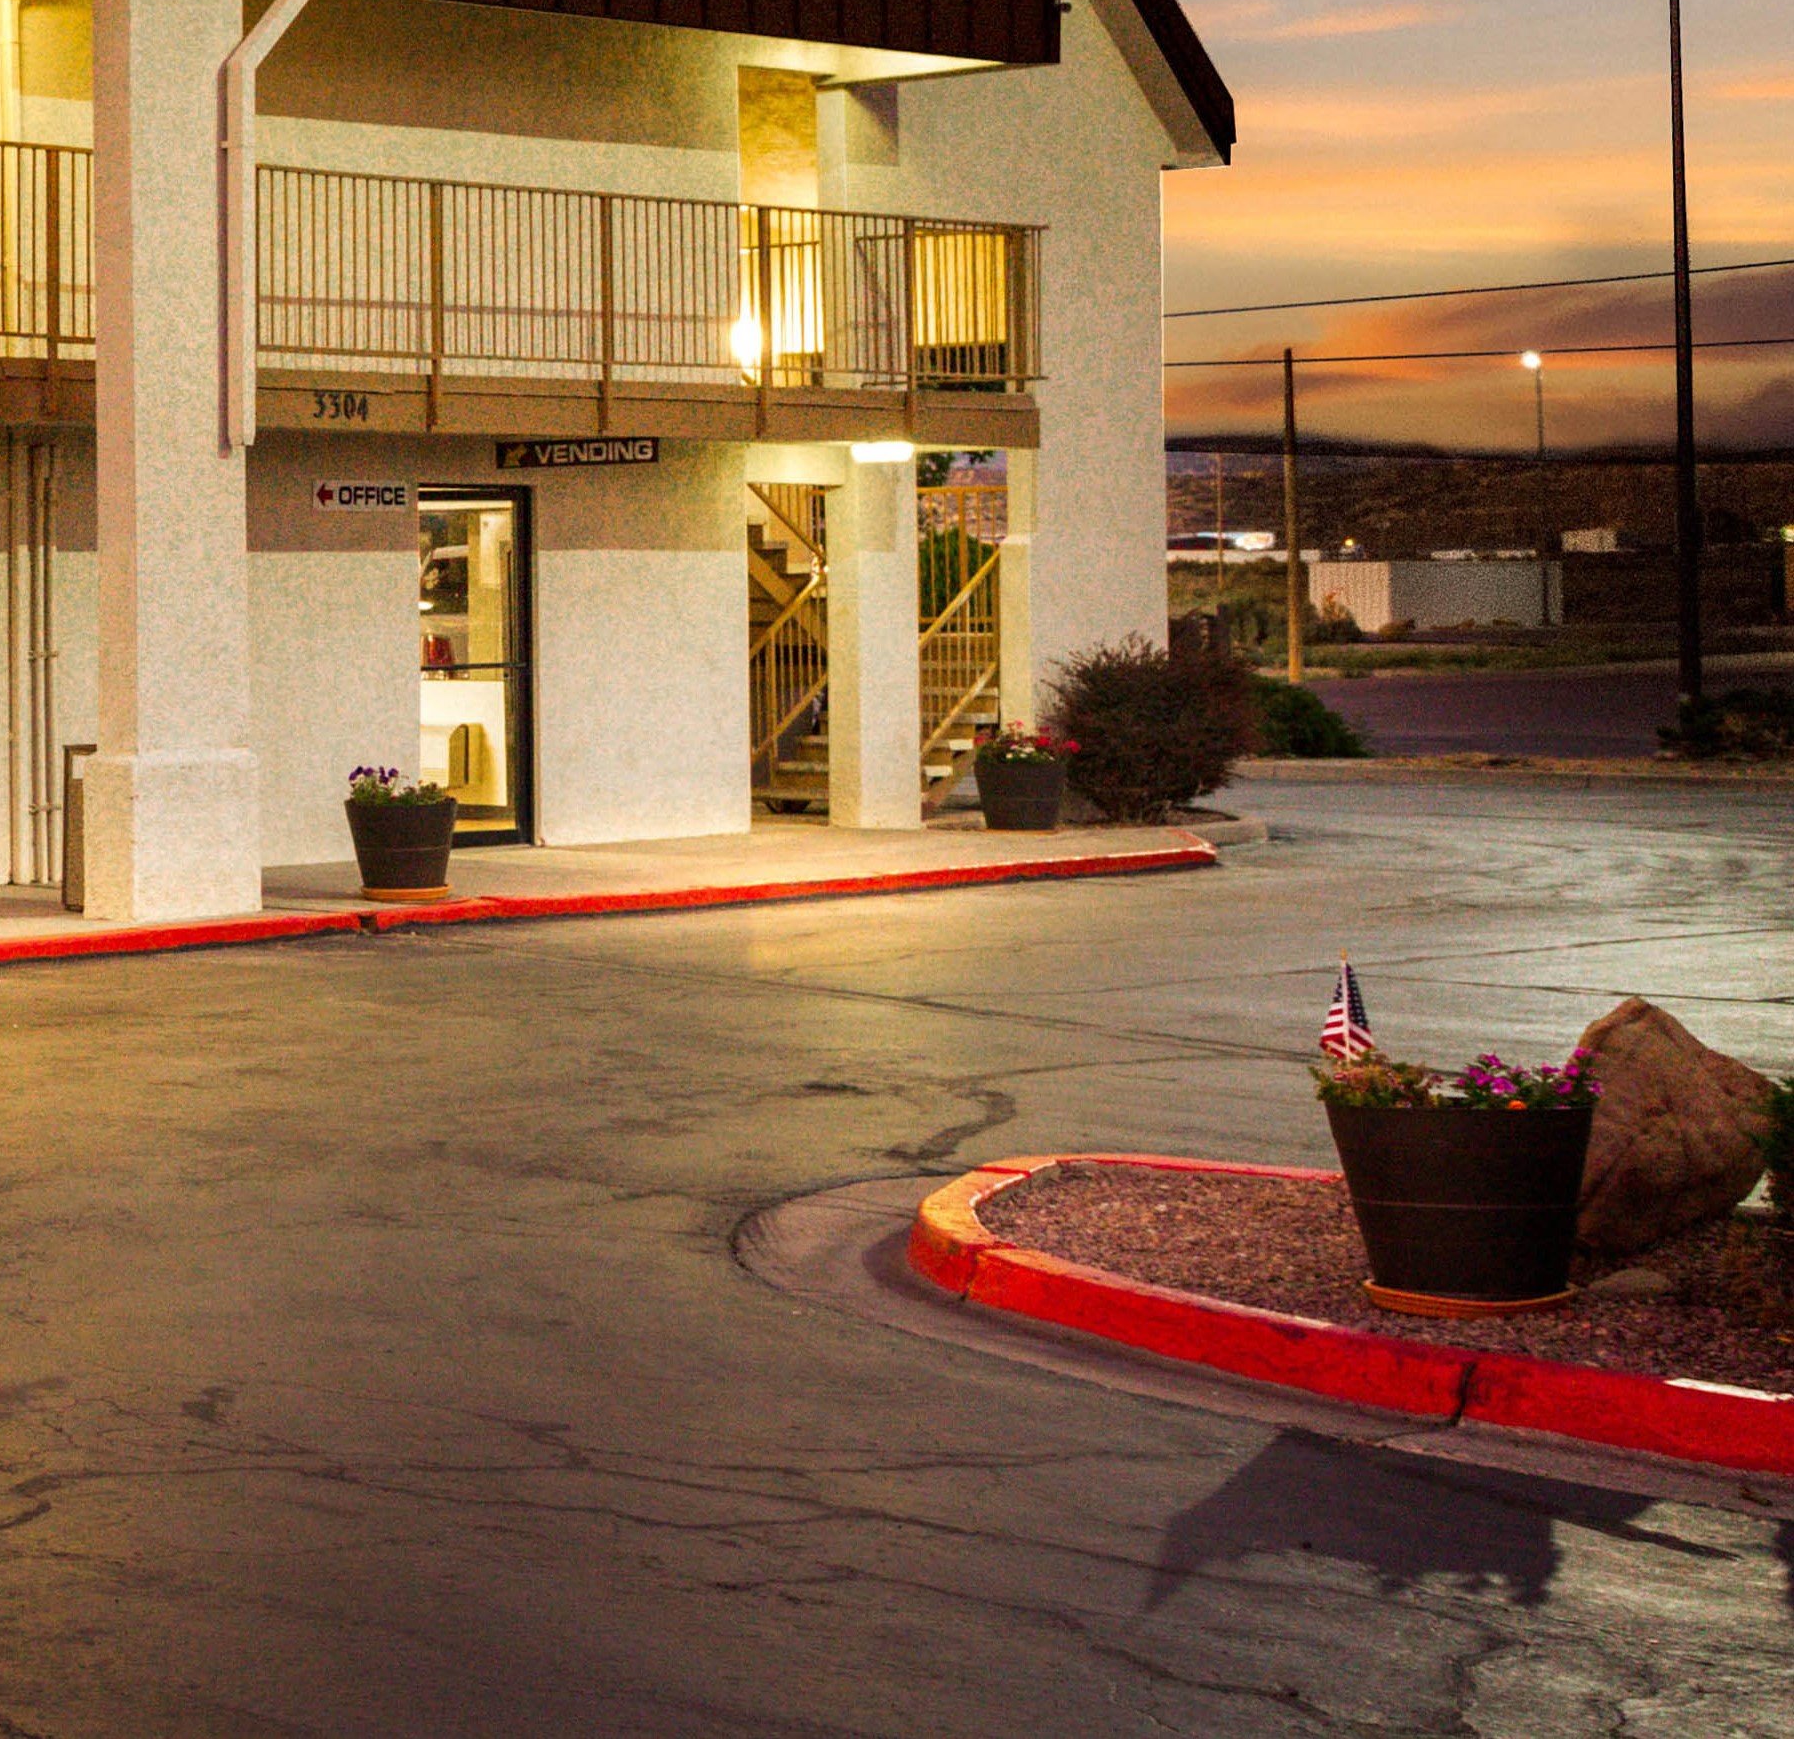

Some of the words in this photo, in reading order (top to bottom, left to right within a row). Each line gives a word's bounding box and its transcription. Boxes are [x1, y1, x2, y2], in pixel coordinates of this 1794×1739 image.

[313, 391, 369, 421] 3304
[534, 440, 654, 464] VENDING
[338, 486, 406, 506] OFFICE
